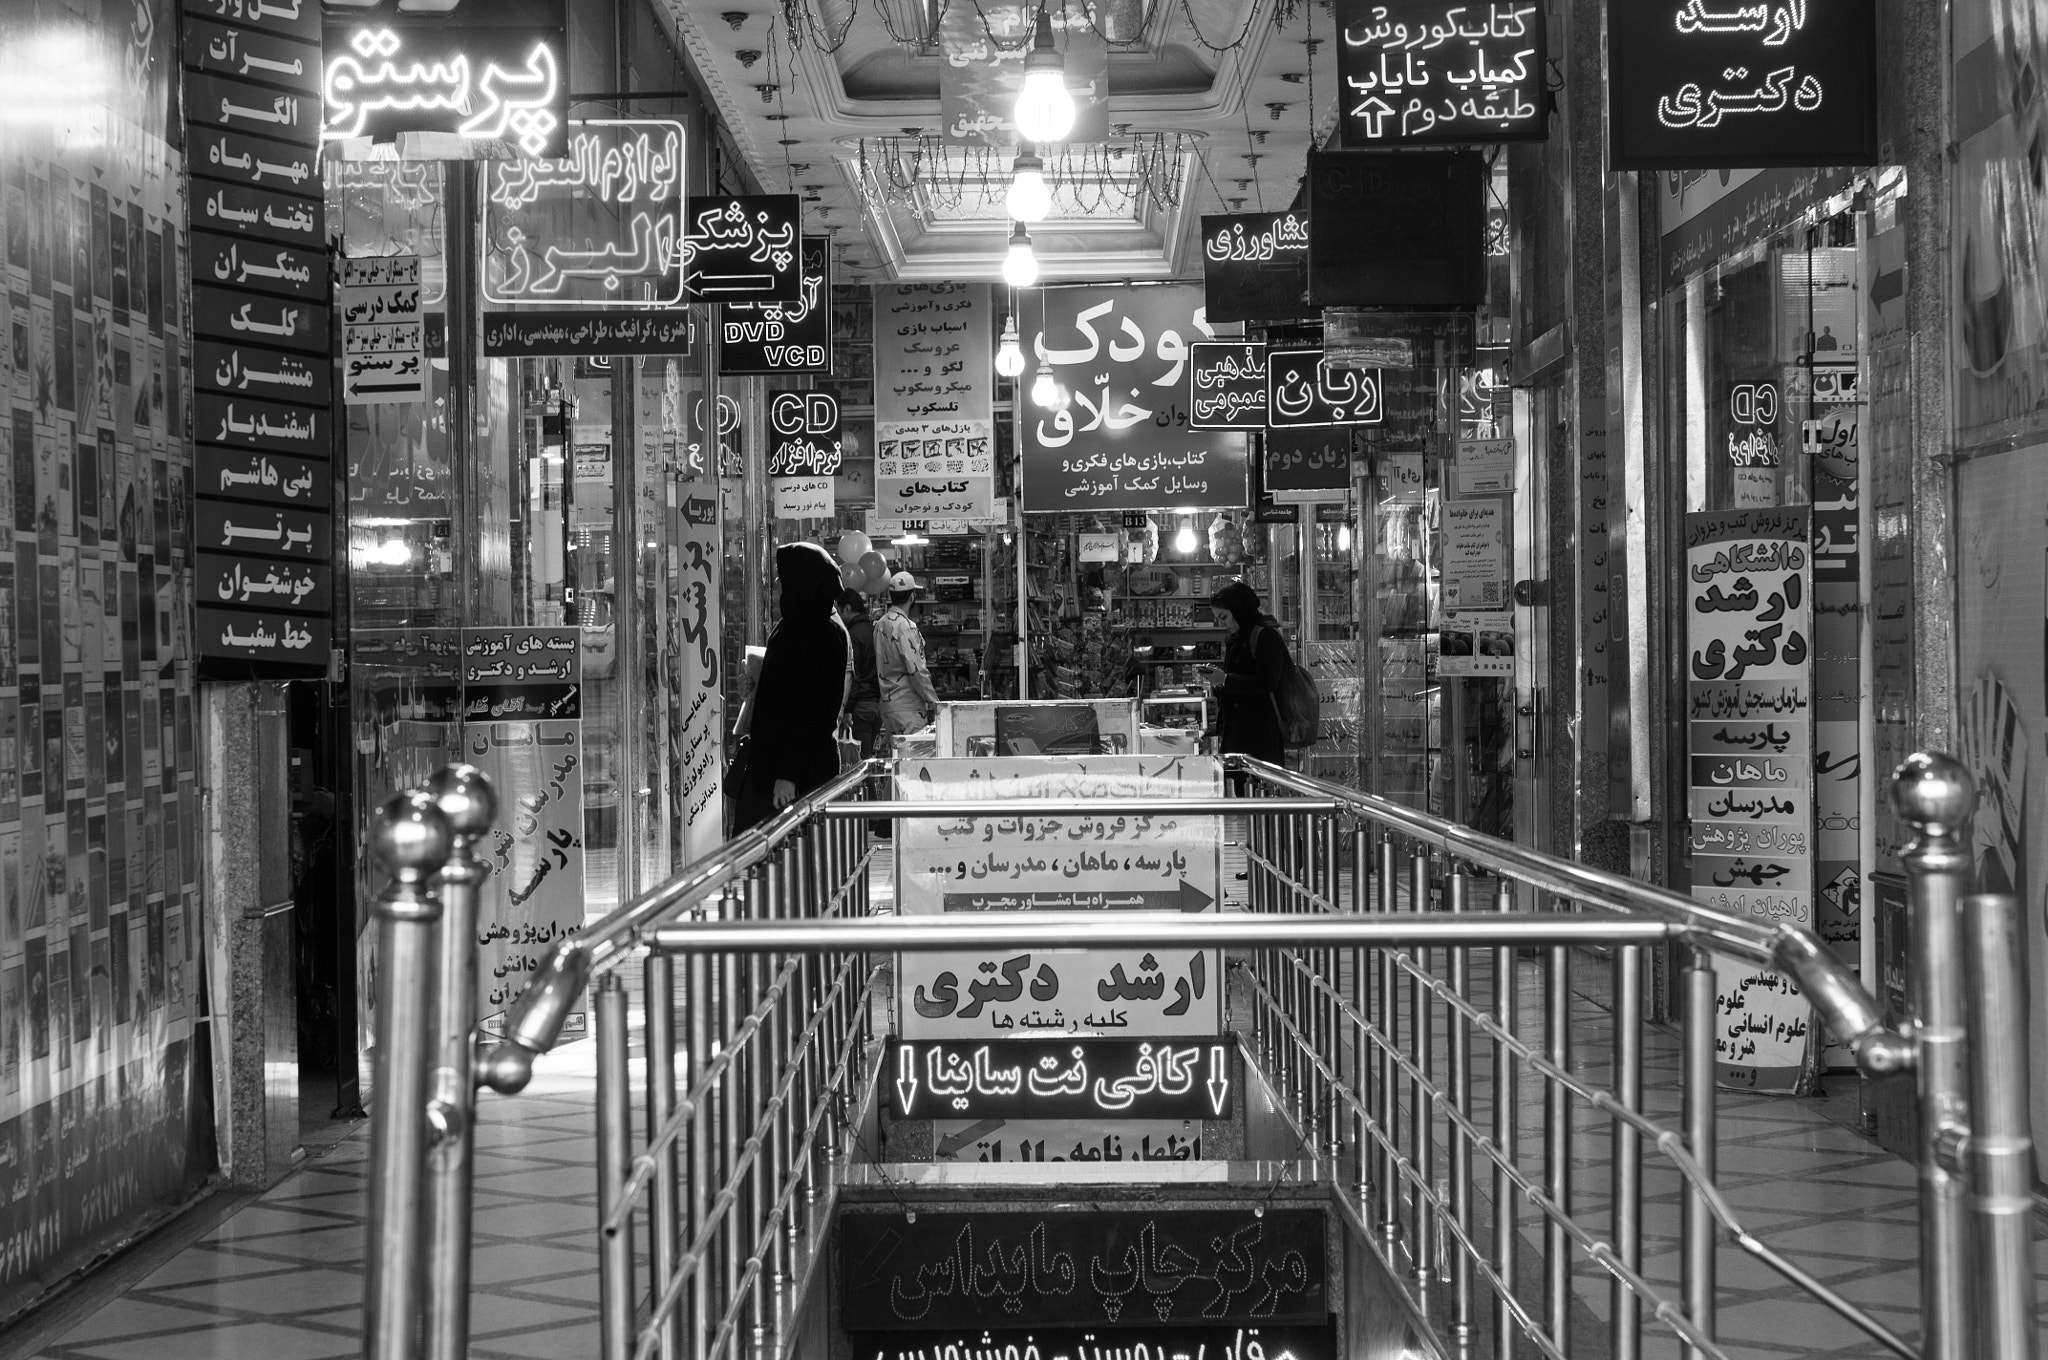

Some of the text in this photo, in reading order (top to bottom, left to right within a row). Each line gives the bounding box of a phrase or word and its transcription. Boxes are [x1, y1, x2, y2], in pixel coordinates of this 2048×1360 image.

[1344, 4, 1536, 50] کتاب کوروش
[238, 52, 303, 75] مر
[1347, 48, 1535, 95] کمیاب نایاب
[323, 28, 557, 156] پرستو
[1657, 66, 1823, 128] دکتری
[218, 97, 298, 127] الگو
[1401, 98, 1458, 136] دوم
[209, 137, 251, 170] ماه
[602, 131, 678, 202] لوازم
[251, 157, 309, 184] مهر
[206, 190, 314, 232] تخته سیاه
[663, 201, 793, 272] پزشکی
[214, 243, 311, 289] مبتکران
[497, 212, 684, 294] البرز
[230, 303, 299, 337] کلک
[345, 290, 418, 322] کمک درسی
[891, 300, 933, 313] آموزشی
[943, 300, 972, 312] فکری
[487, 320, 517, 347] اداری
[725, 322, 784, 343] DVD
[897, 321, 967, 336] اسباب بازی
[764, 345, 825, 366] VCD
[903, 342, 960, 356] عروسک
[216, 349, 314, 388] منتشران
[940, 361, 963, 375] لگو
[893, 382, 972, 397] میکروسکوپ
[1276, 352, 1377, 419] زبان
[216, 403, 315, 442] اسفندیار
[772, 393, 838, 435] CD
[907, 401, 959, 417] تلسکوپ
[895, 425, 919, 435] بعدی
[768, 437, 842, 475] نرم افزار
[1071, 452, 1107, 473] فکری
[1269, 445, 1348, 471] زبان دوم
[220, 457, 279, 491] هاشم
[283, 466, 313, 498] بنی
[780, 482, 828, 493] CD های درسی
[1064, 474, 1208, 498] وسایل کمک آموزشی
[801, 502, 812, 511] نور
[812, 502, 826, 511] پیام
[895, 503, 931, 514] نوجوان
[942, 502, 974, 513] کودک
[1134, 517, 1145, 526] 13
[1728, 512, 1749, 529] کتب
[221, 512, 313, 553] پرتو
[1751, 514, 1782, 534] فروش
[1782, 516, 1807, 542] مرکز
[1692, 541, 1805, 583] دانشگاهی
[218, 563, 316, 605] خوشخوان
[1695, 573, 1801, 622] ارشد
[682, 541, 718, 688] پزشکی
[221, 618, 314, 654] خط سفید
[466, 635, 575, 656] بسته های آموزشی
[1692, 622, 1807, 680] دکتری
[467, 659, 572, 681] ارشد و دکتری
[681, 691, 708, 733] مامایی
[1691, 683, 1807, 718] سازمان سنجش آموزش کشور
[684, 724, 711, 767] پرستاری
[1712, 722, 1790, 753] پارسه
[683, 752, 714, 797] رادیولوژی
[1710, 758, 1788, 784] ماهان
[687, 781, 718, 827] دندانپزشکی
[1708, 790, 1794, 819] مدرسان
[997, 816, 1064, 842] جزوات
[1067, 816, 1127, 841] فروش
[1692, 823, 1806, 855] پوران پژوهش
[508, 827, 582, 907] پارسه
[971, 851, 1047, 879] مدرسان
[1712, 857, 1791, 887] جهش
[972, 893, 1023, 910] مجرب
[1023, 893, 1074, 909] مشاور
[1751, 895, 1809, 922] راهیان
[478, 922, 537, 945] پژوهش
[493, 955, 538, 978] دانش
[1740, 970, 1779, 992] مهندسی
[913, 950, 1206, 1019] ارشد دکتری
[991, 1009, 1128, 1036] کلیه رشته ها
[1728, 1012, 1807, 1043] علوم انسانی
[1737, 1037, 1756, 1061] هنر
[1028, 1046, 1087, 1097] نت
[1094, 1042, 1200, 1110] کافی
[1090, 1220, 1200, 1323] چاپ
[1202, 1221, 1307, 1318] مرکز
